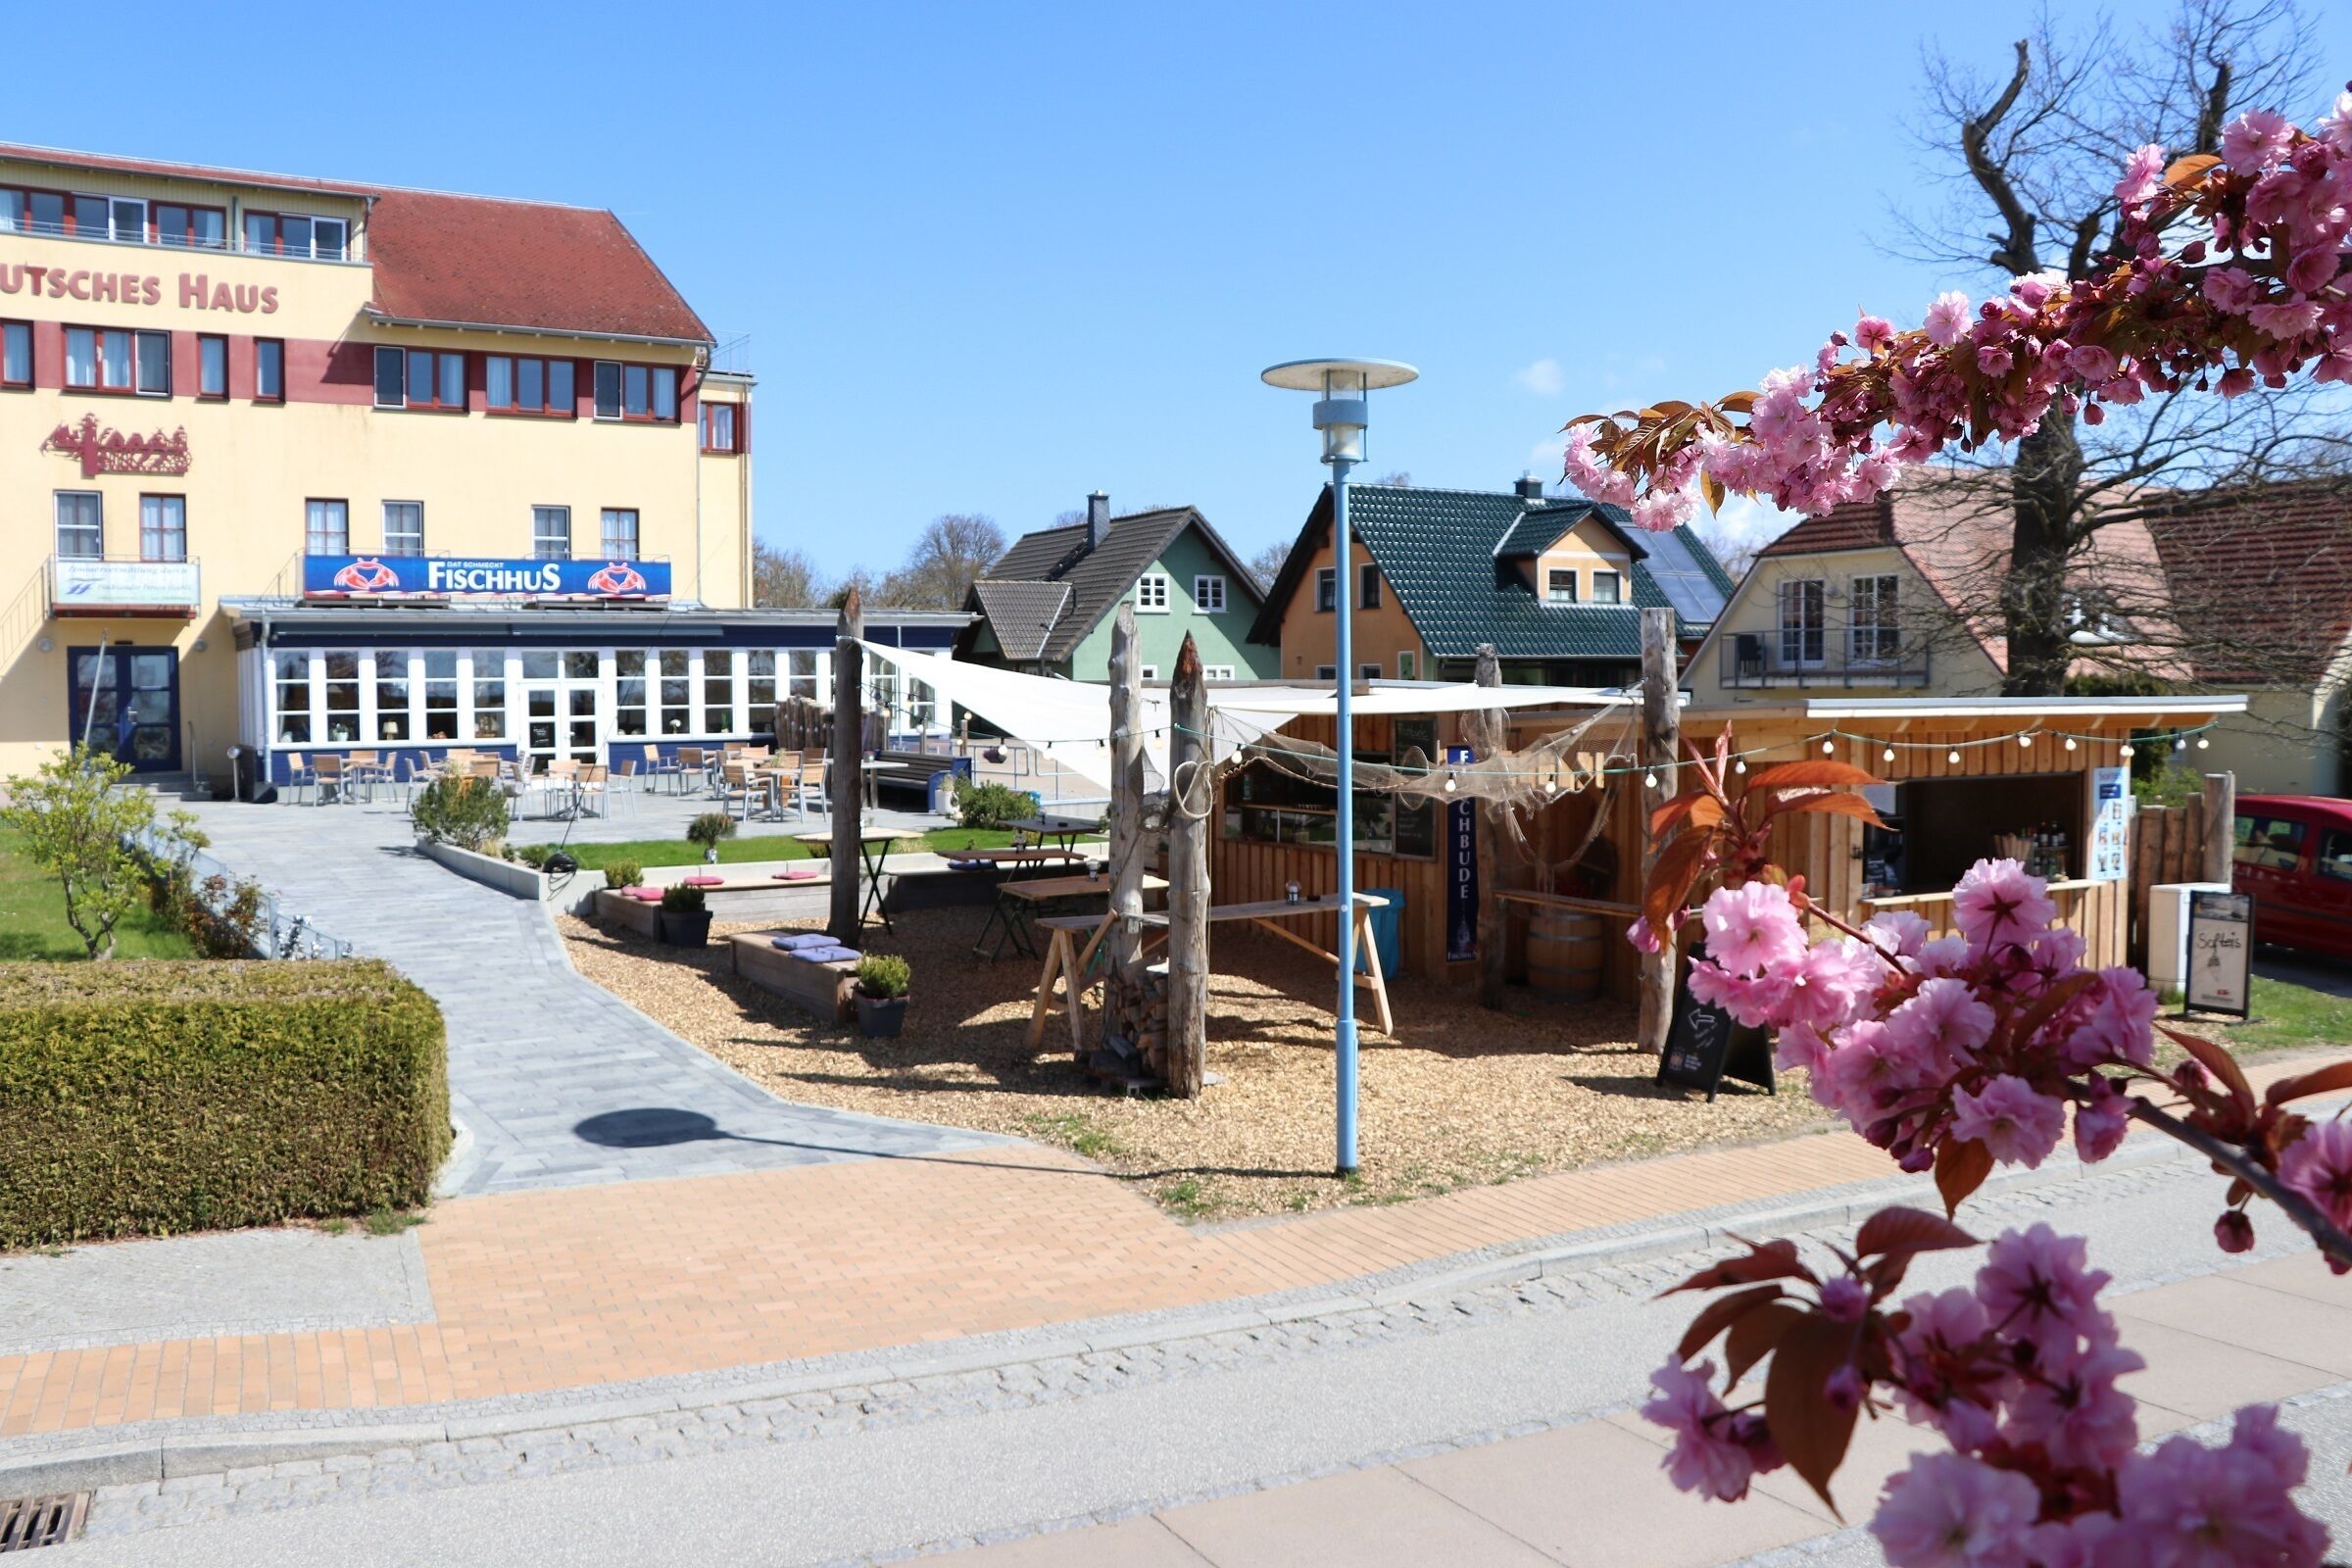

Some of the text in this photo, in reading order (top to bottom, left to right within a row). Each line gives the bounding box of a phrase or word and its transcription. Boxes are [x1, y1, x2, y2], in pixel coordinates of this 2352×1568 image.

[178, 272, 279, 315] HAUS
[428, 562, 561, 591] FISCHHUS
[1459, 750, 1471, 899] FCHBUDE
[2196, 932, 2241, 953] Softeis
